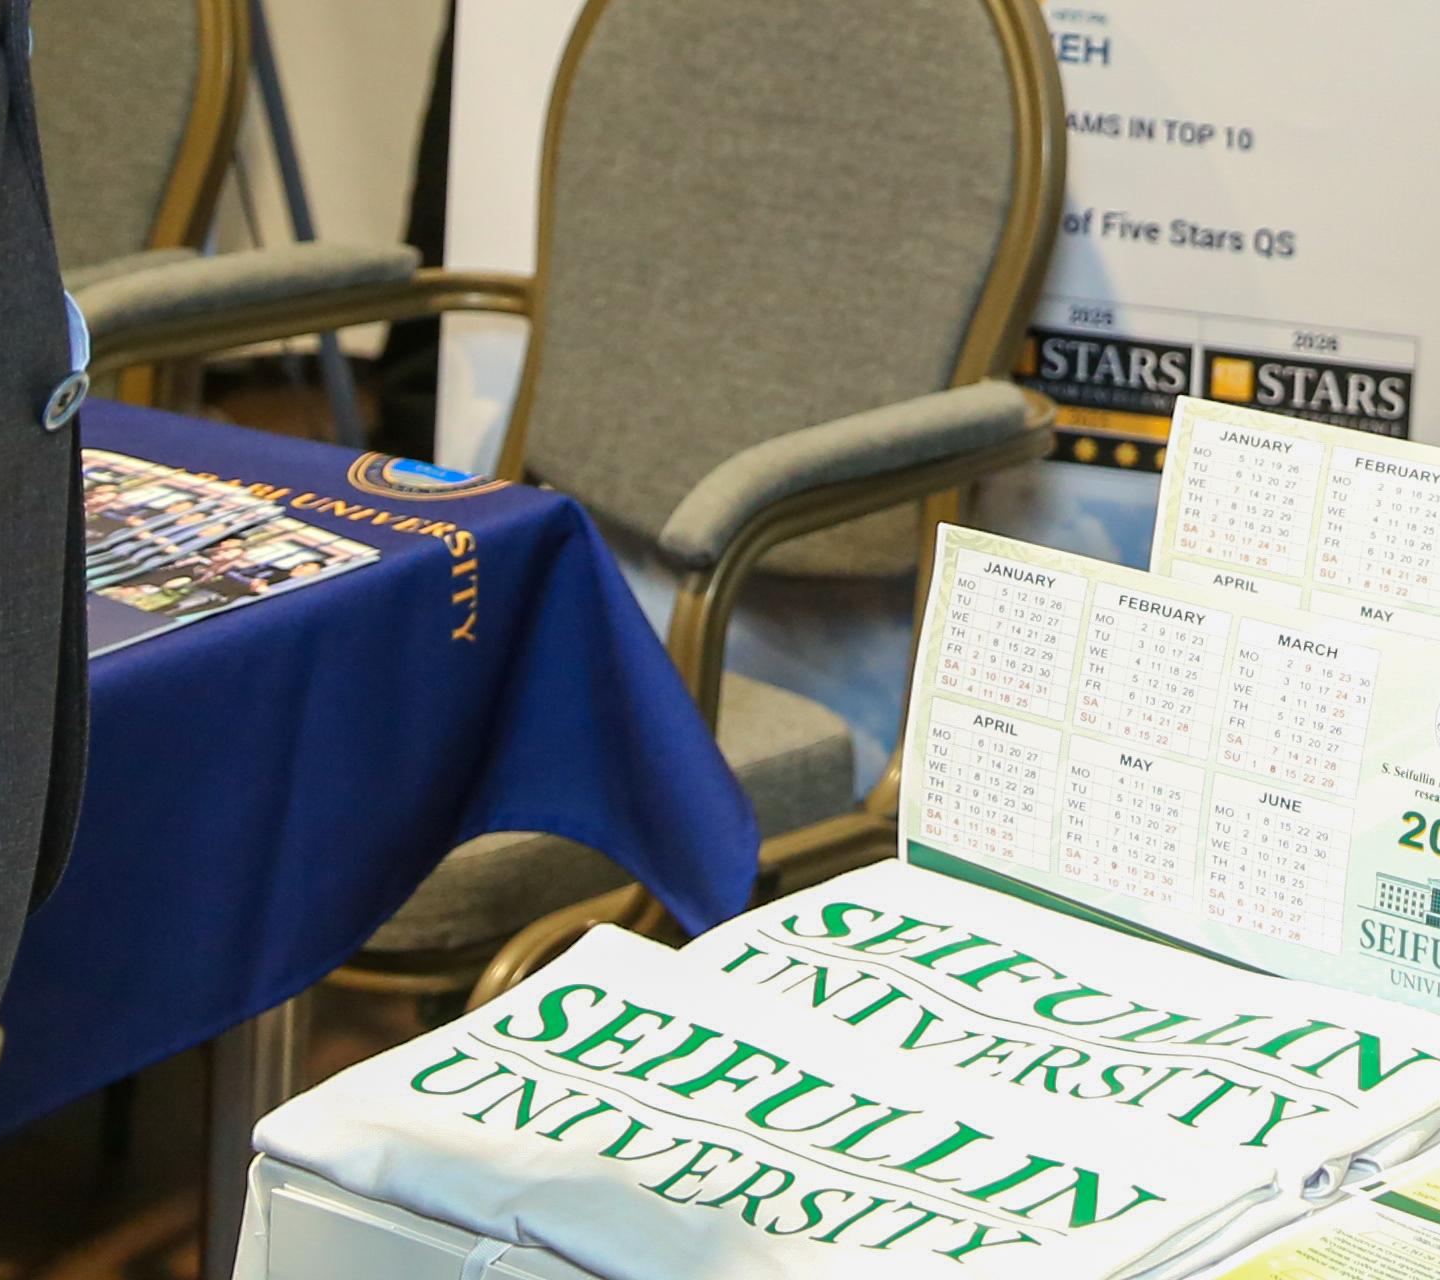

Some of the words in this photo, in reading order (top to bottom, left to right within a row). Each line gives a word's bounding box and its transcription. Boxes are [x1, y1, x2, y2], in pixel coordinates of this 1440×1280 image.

[1128, 116, 1154, 141] IN
[1164, 119, 1215, 145] TOP
[1225, 127, 1254, 151] 10
[1102, 211, 1161, 243] Five
[1169, 220, 1244, 252] Stars
[1253, 228, 1296, 259] QS
[1041, 340, 1188, 393] STARS
[1256, 364, 1407, 420] STARS
[1219, 431, 1292, 454] JANUARY
[290, 491, 478, 642] UNIVERSITY
[983, 561, 1057, 589] JANUARY
[1118, 595, 1206, 626] FEBRUARY
[1277, 633, 1338, 660] MARCH
[972, 714, 1018, 737] APRIL
[1119, 753, 1154, 774] MAY
[1394, 766, 1435, 786] Seifullin
[1259, 792, 1303, 814] JUNE
[721, 943, 1330, 1149] UNIVERSITY
[492, 983, 1168, 1231] SEIFULLIN
[409, 1047, 1042, 1267] UNIVERSITY
